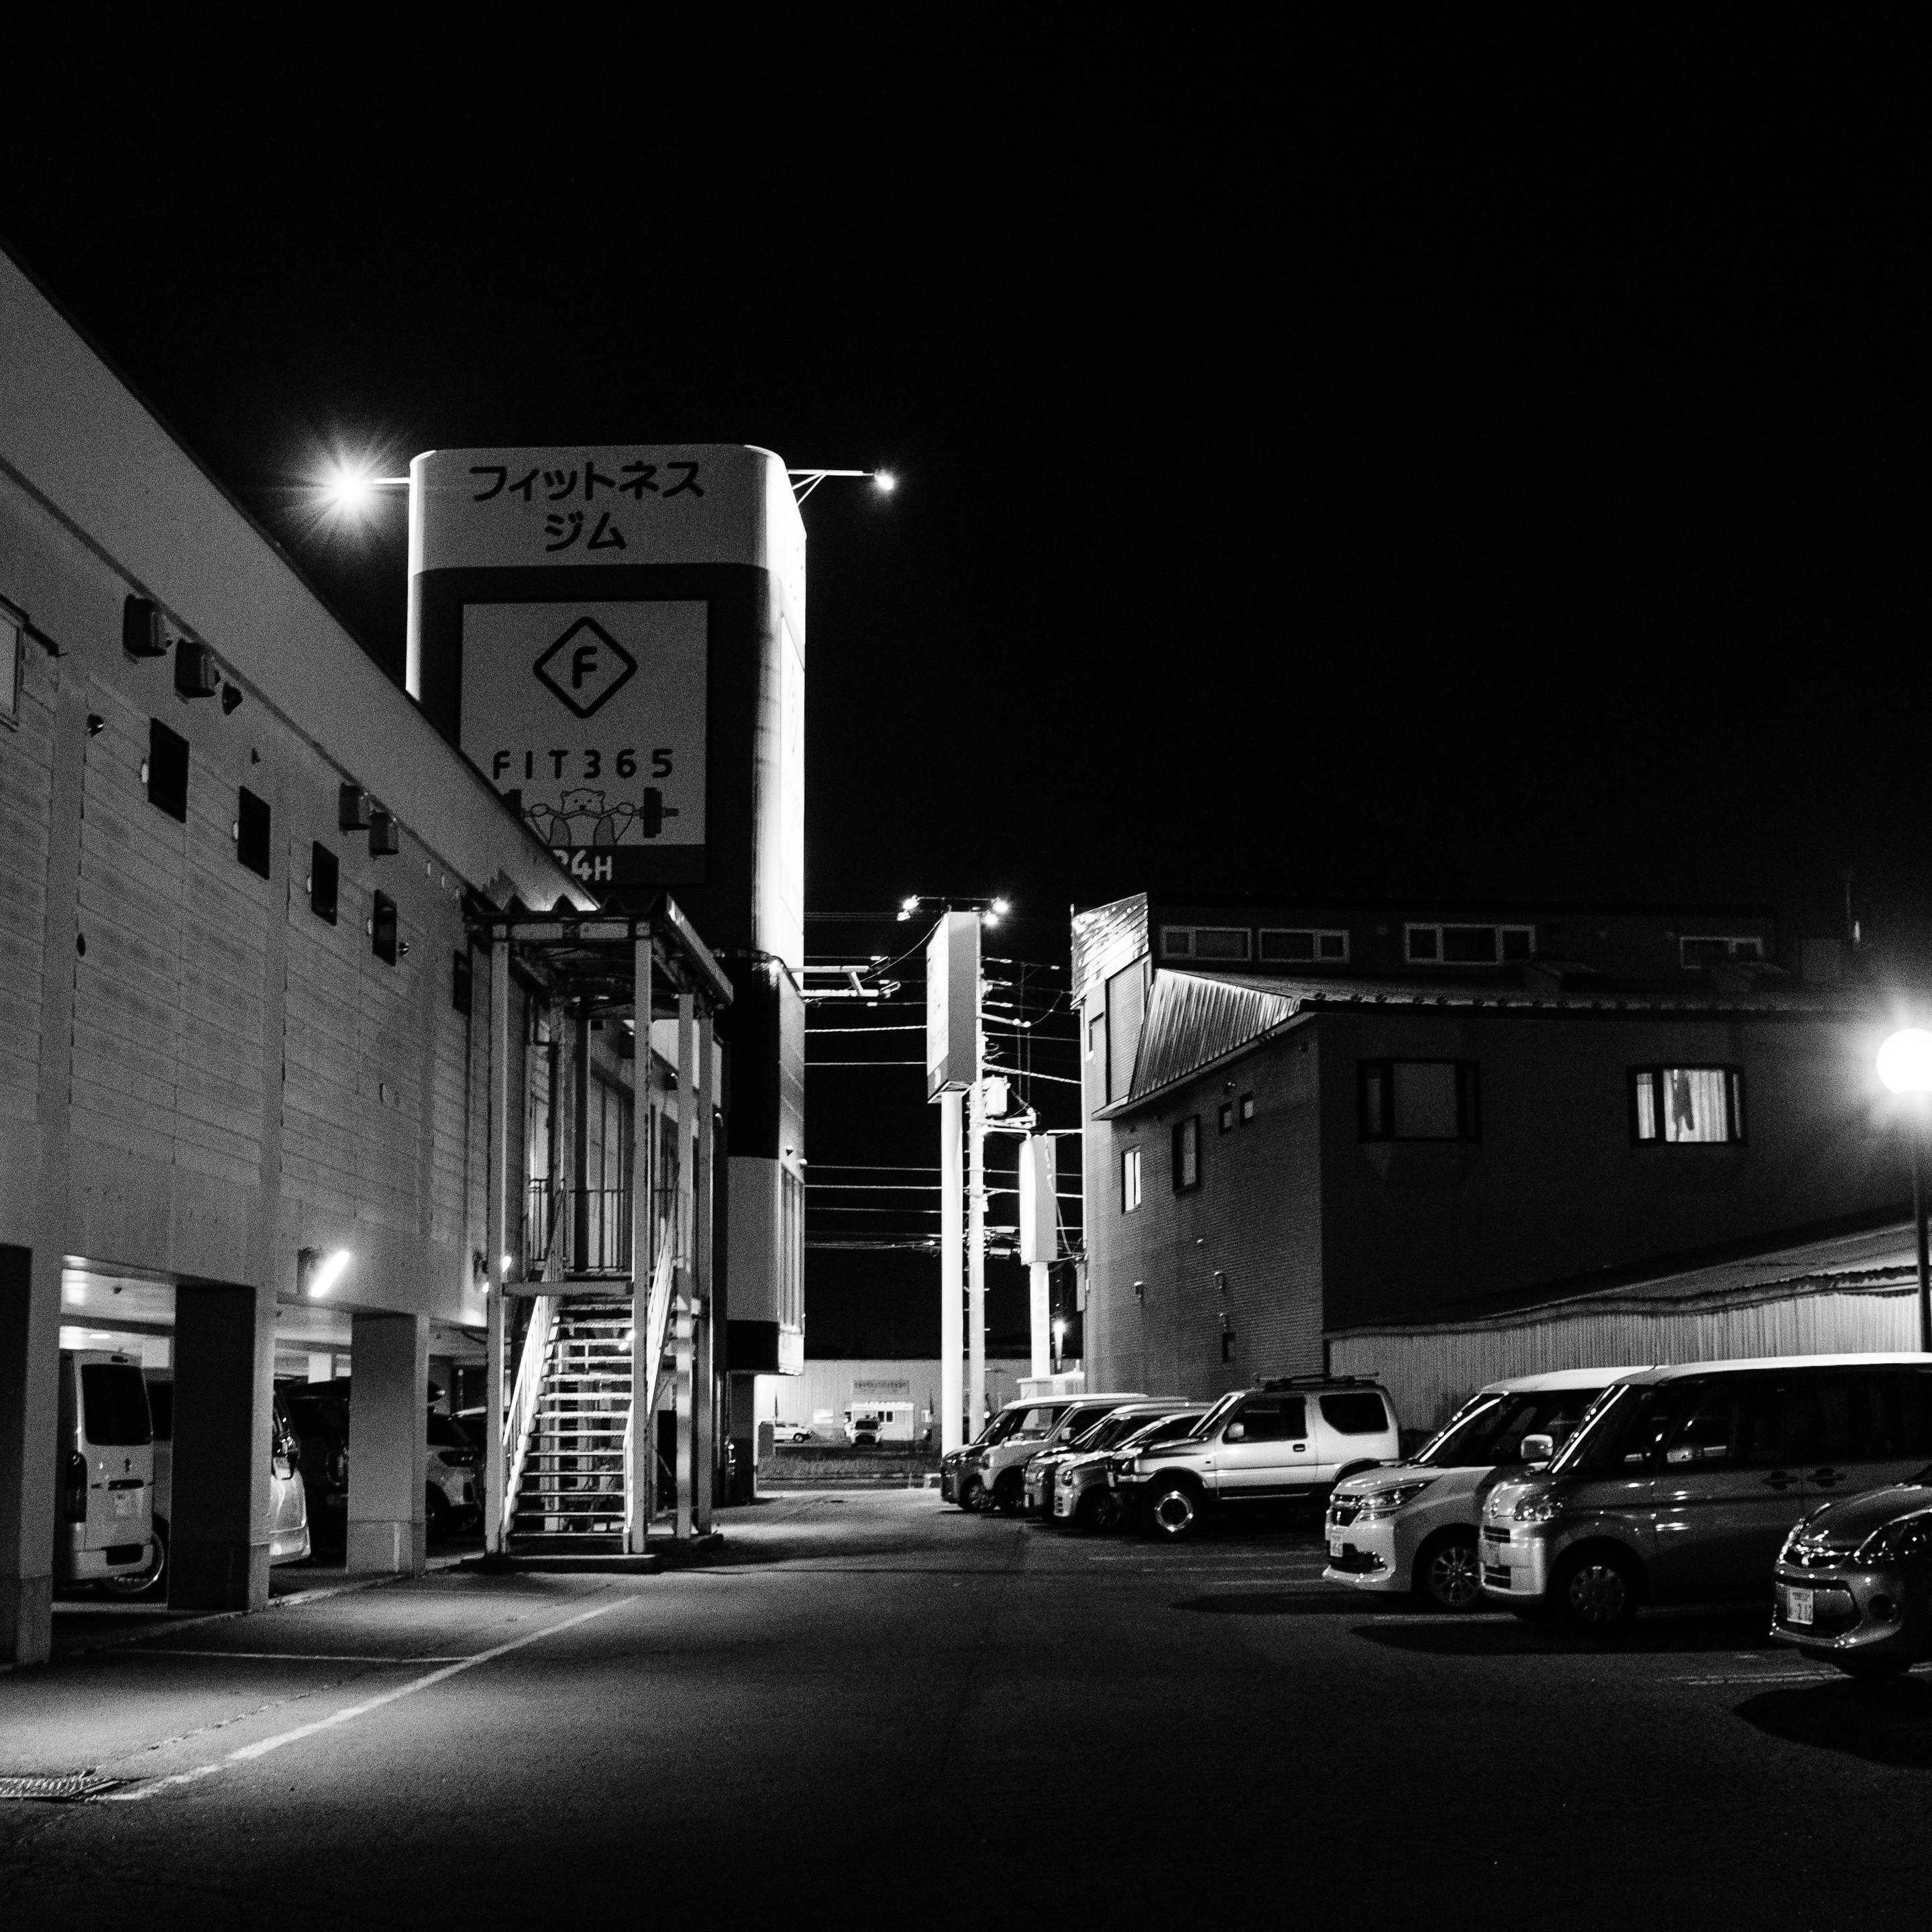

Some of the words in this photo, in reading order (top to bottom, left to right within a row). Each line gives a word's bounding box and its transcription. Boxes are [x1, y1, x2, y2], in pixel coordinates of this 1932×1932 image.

[470, 461, 704, 501] フィットネス
[545, 511, 627, 552] ジム
[572, 645, 598, 689] F
[492, 748, 673, 780] FIT365
